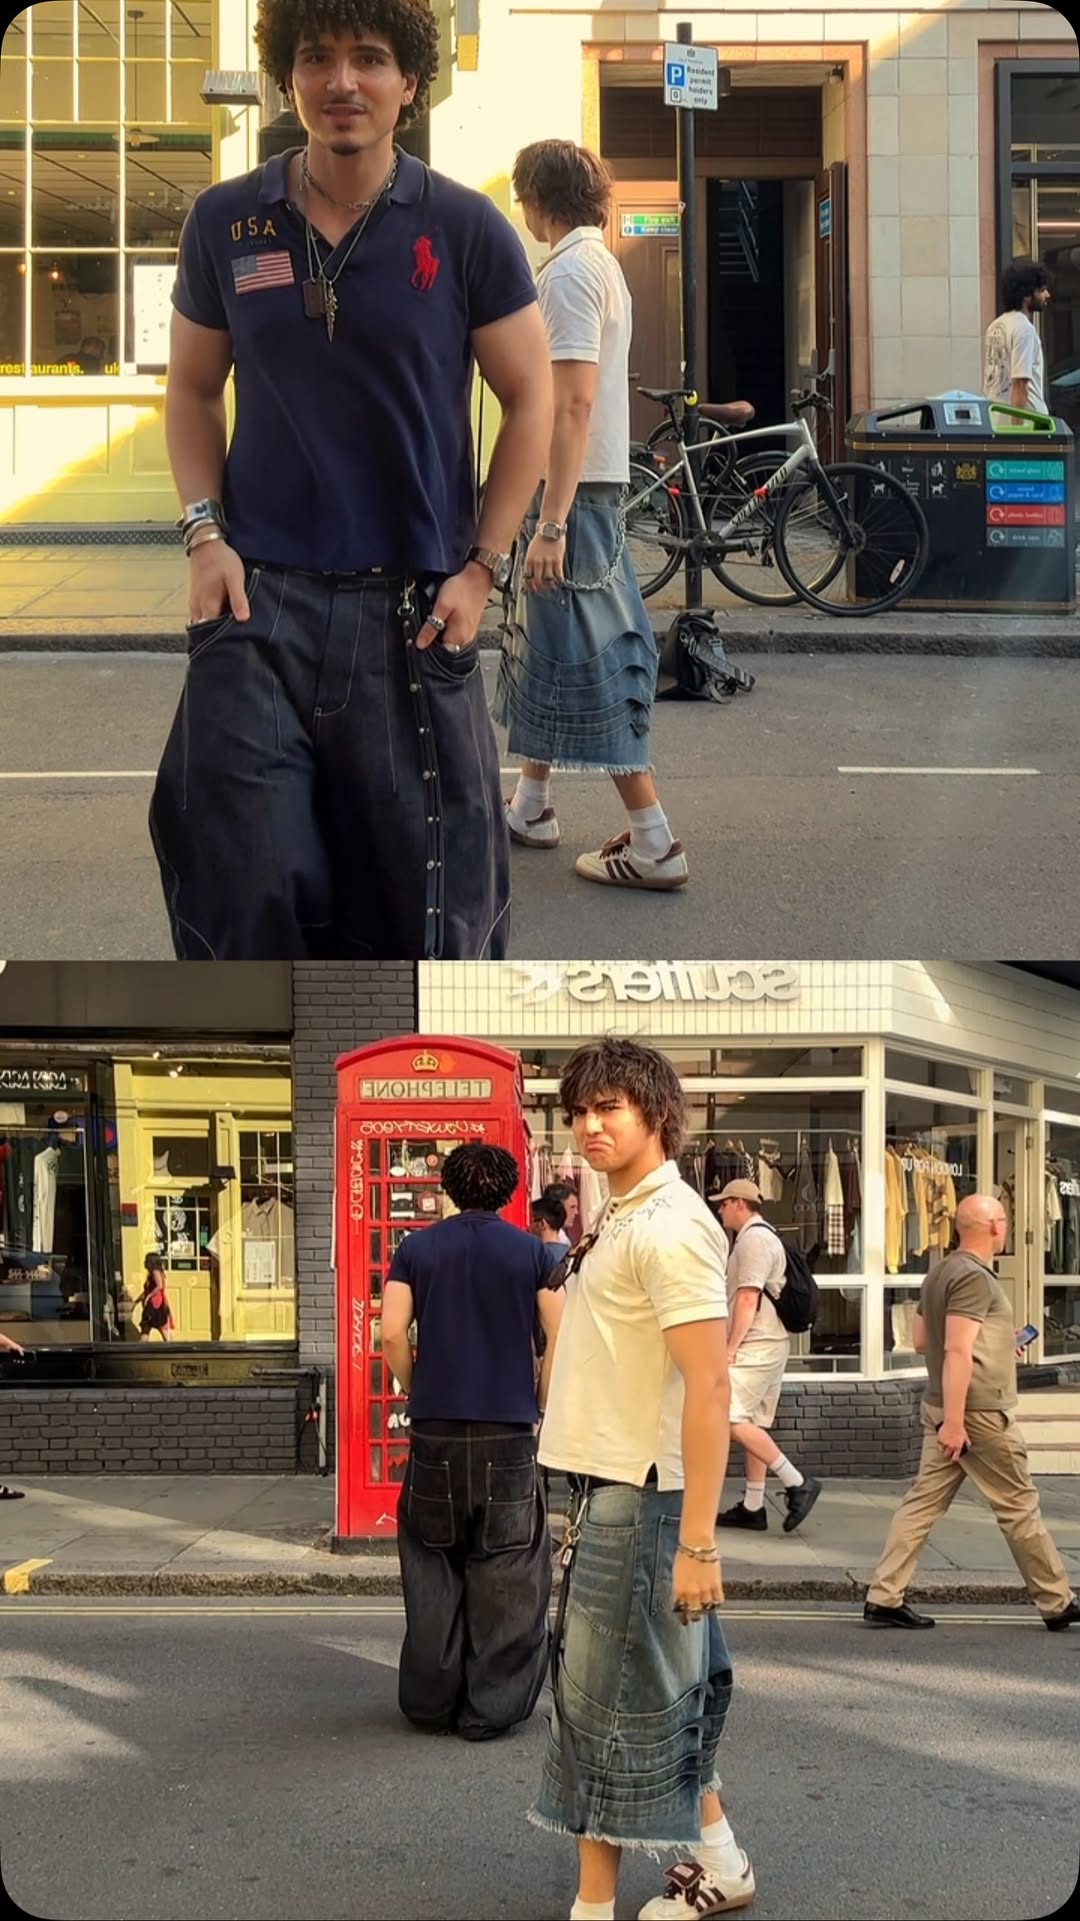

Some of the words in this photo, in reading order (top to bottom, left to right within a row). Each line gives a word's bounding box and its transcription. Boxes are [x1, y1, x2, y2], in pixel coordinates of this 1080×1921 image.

[671, 66, 682, 84] P
[687, 65, 715, 77] Resident
[690, 77, 712, 86] permit
[688, 86, 713, 96] holders
[694, 96, 708, 105] only
[231, 216, 277, 241] USA
